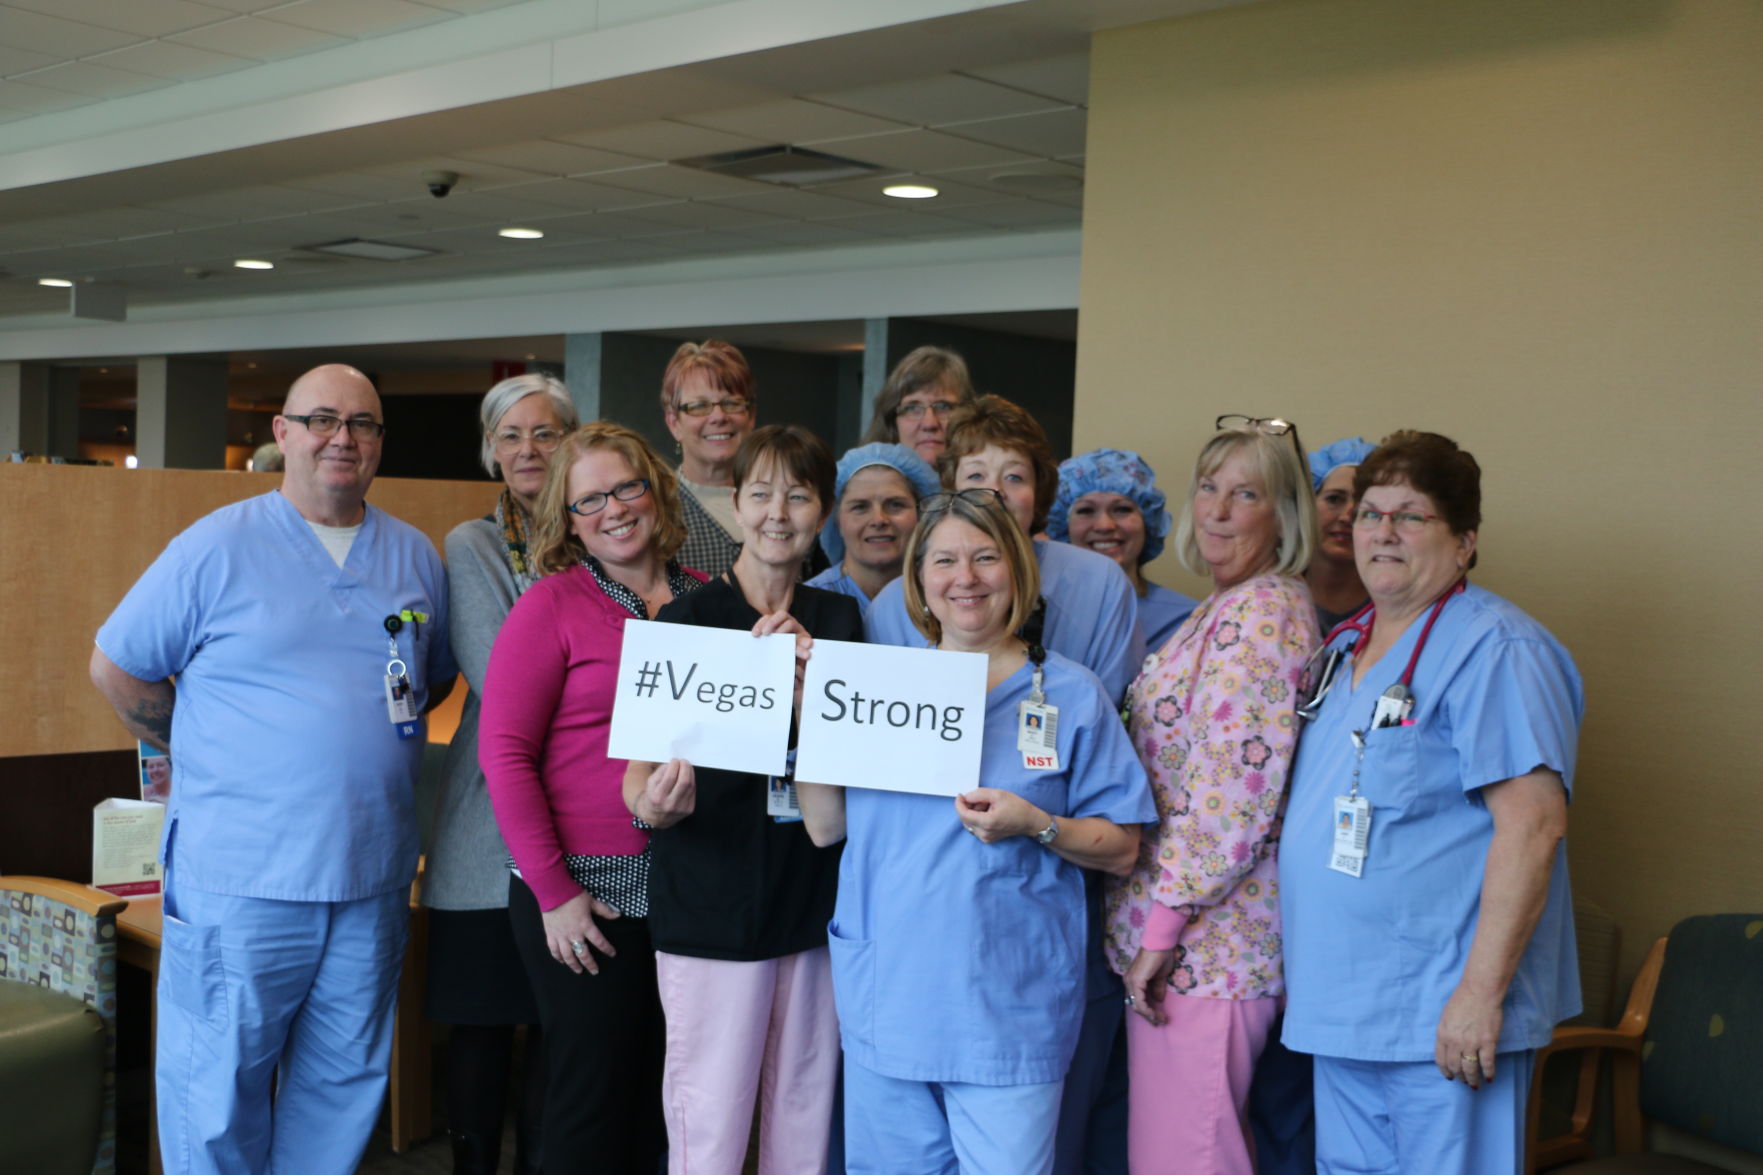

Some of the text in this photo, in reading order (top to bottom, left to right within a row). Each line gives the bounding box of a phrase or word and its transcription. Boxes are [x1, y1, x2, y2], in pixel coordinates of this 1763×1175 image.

[635, 660, 775, 712] #Vegas
[821, 679, 965, 742] Strong
[1026, 756, 1053, 767] NST
